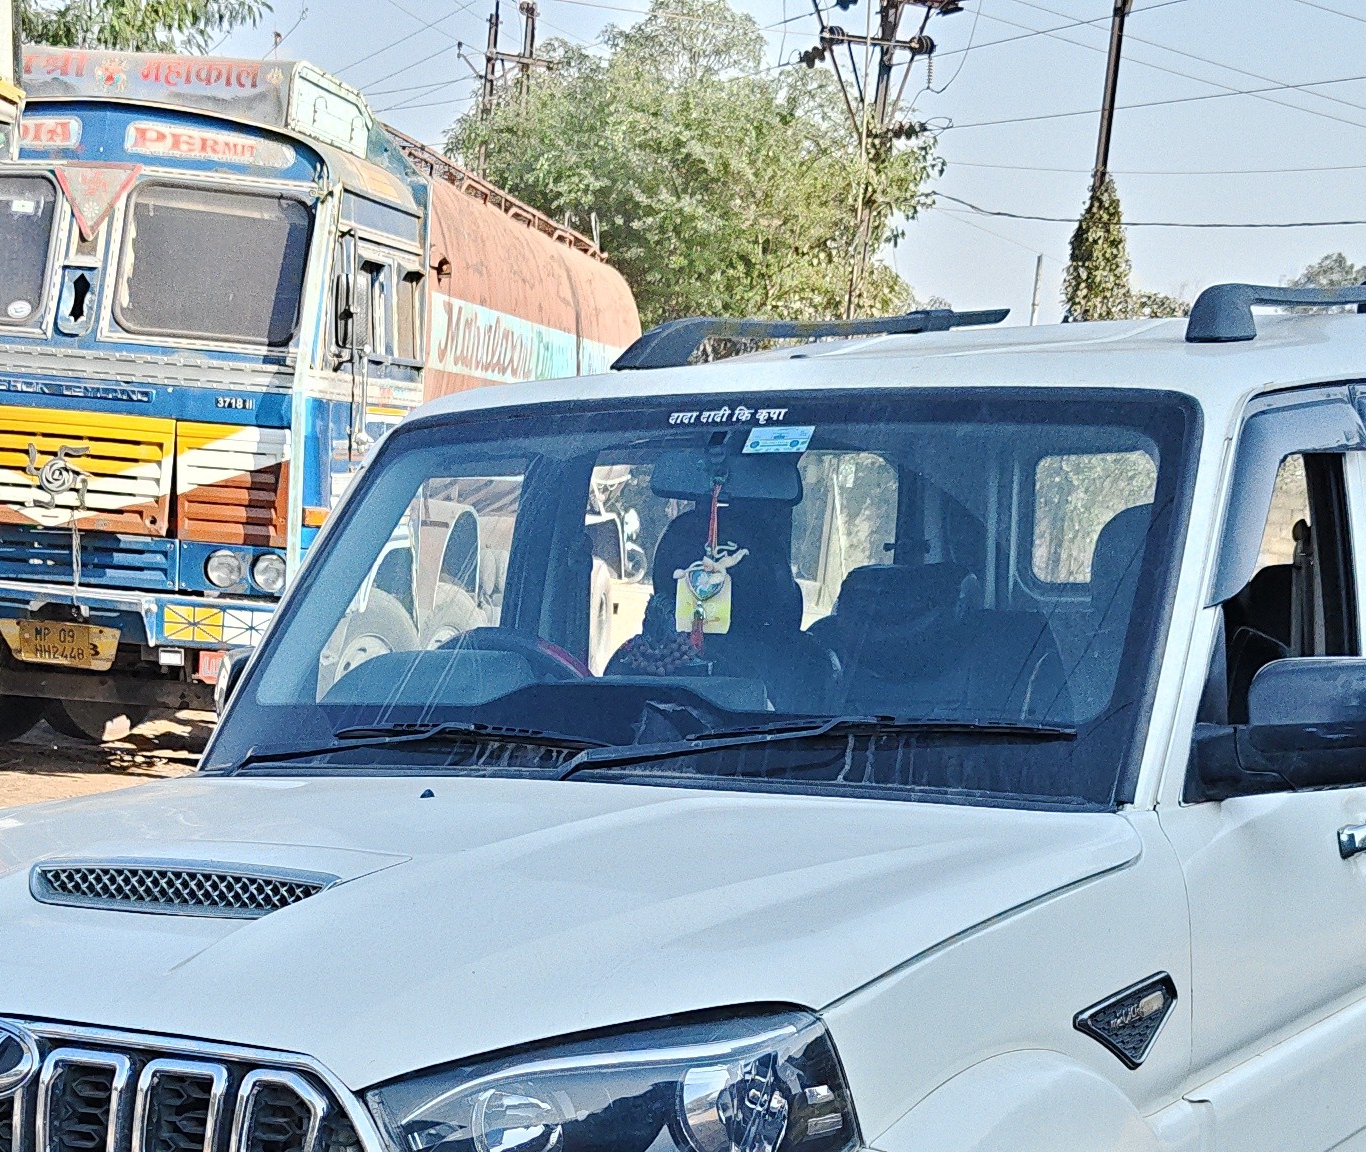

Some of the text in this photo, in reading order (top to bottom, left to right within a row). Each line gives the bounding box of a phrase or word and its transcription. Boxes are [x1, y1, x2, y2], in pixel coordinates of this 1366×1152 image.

[140, 57, 262, 88] महाकाल
[134, 127, 257, 158] PERMIT
[217, 397, 244, 410] 3718
[755, 408, 789, 425] कृपा
[34, 626, 75, 644] MP 09
